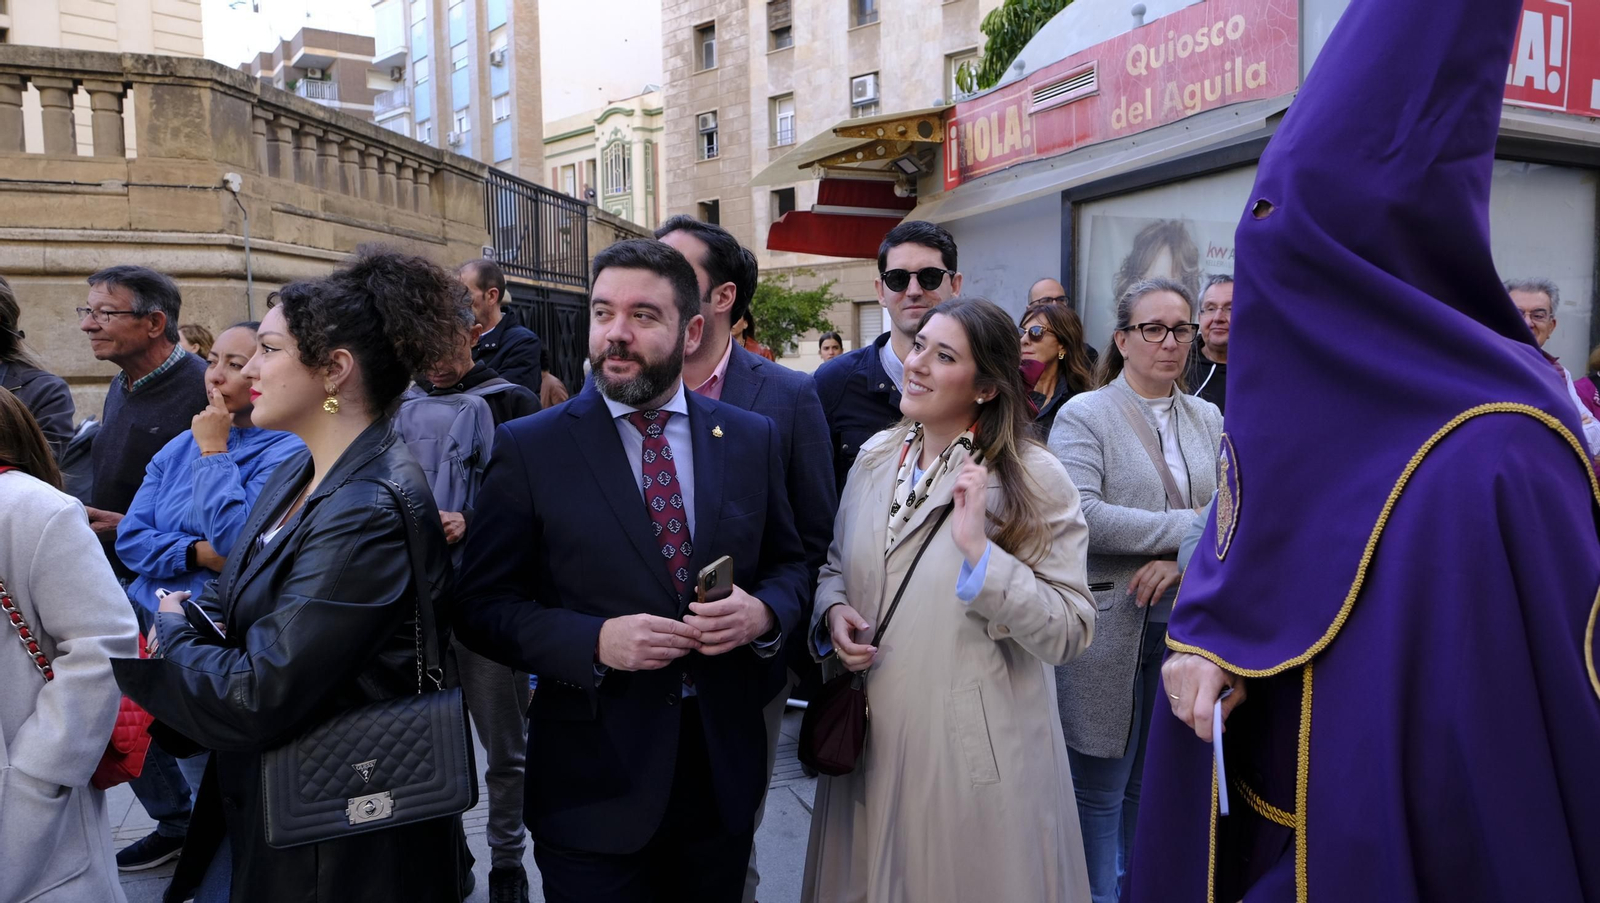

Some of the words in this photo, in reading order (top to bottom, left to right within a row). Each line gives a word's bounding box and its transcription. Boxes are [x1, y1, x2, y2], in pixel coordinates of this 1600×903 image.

[1126, 14, 1246, 76] Quiosco
[1111, 87, 1152, 130] del
[1161, 56, 1267, 117] Aguila
[950, 100, 1032, 171] ¡HOLA!
